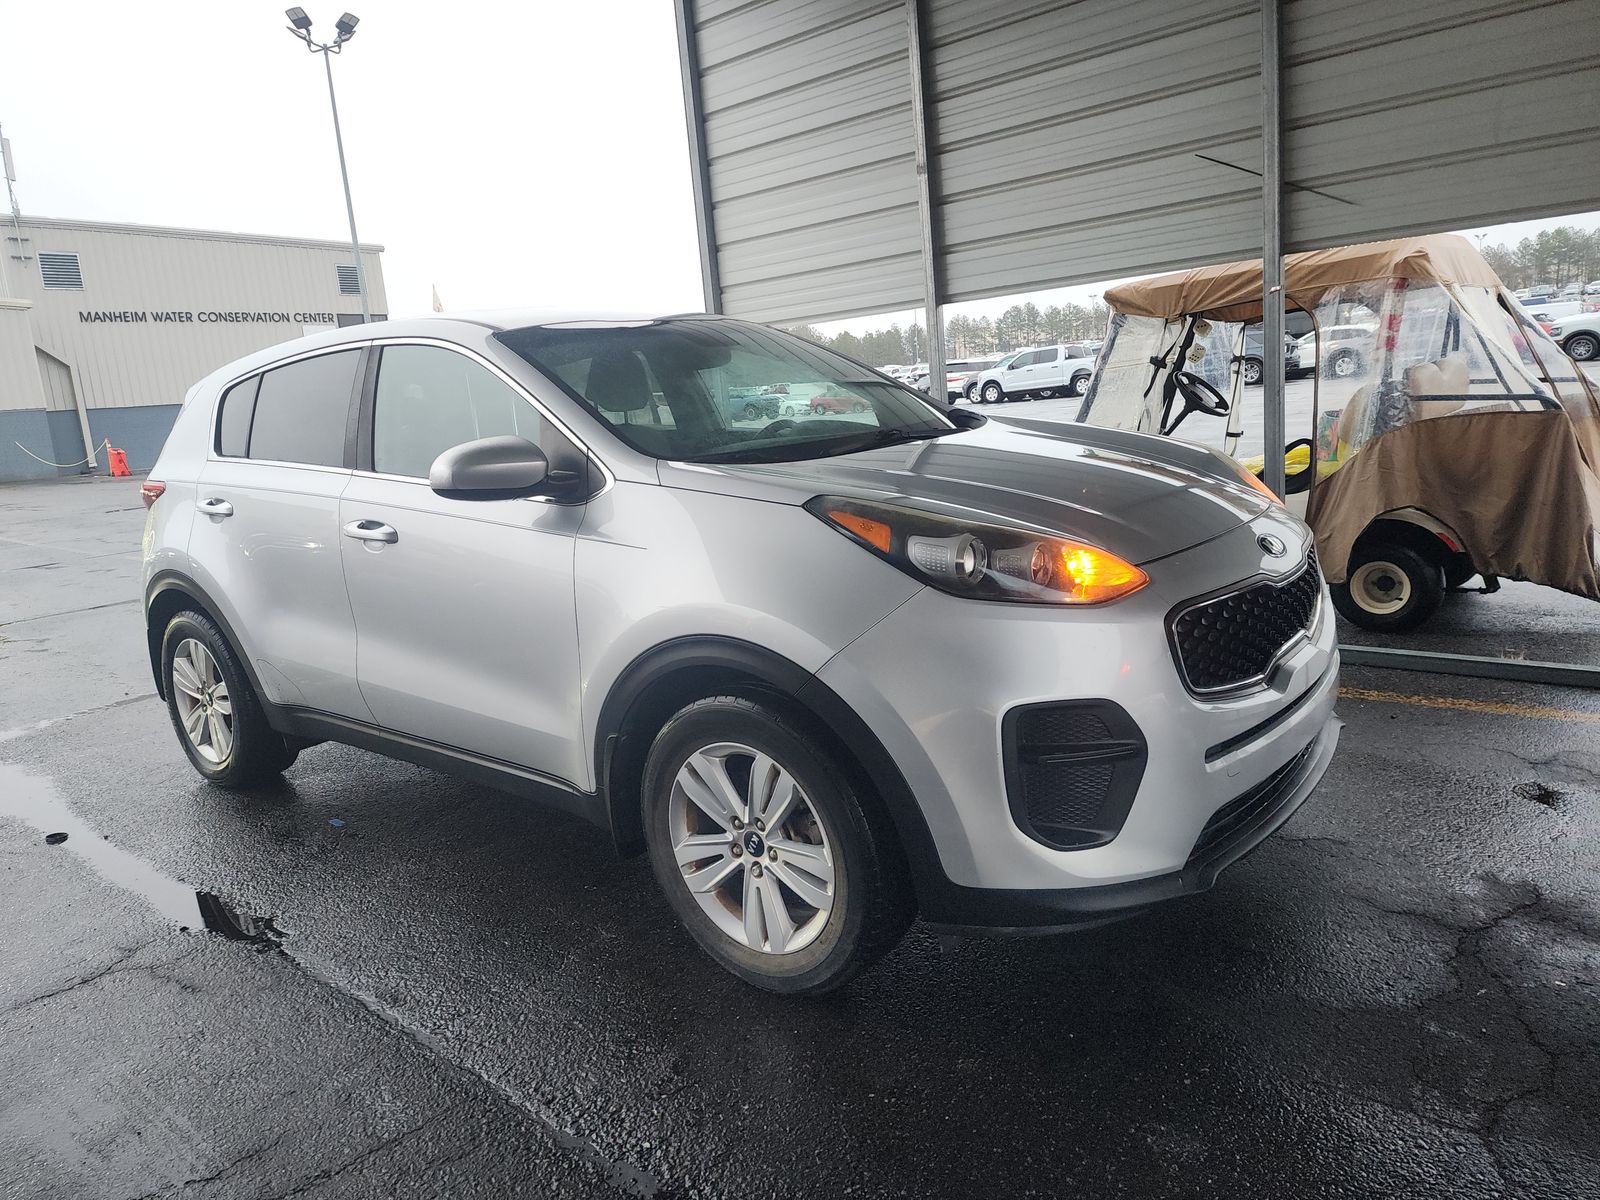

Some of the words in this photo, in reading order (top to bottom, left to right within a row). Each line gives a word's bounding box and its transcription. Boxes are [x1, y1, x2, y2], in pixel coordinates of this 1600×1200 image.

[79, 311, 147, 323] MANHEIM
[151, 311, 194, 323] WATER
[197, 311, 290, 323] CONSERVATION
[293, 312, 335, 323] CENTER
